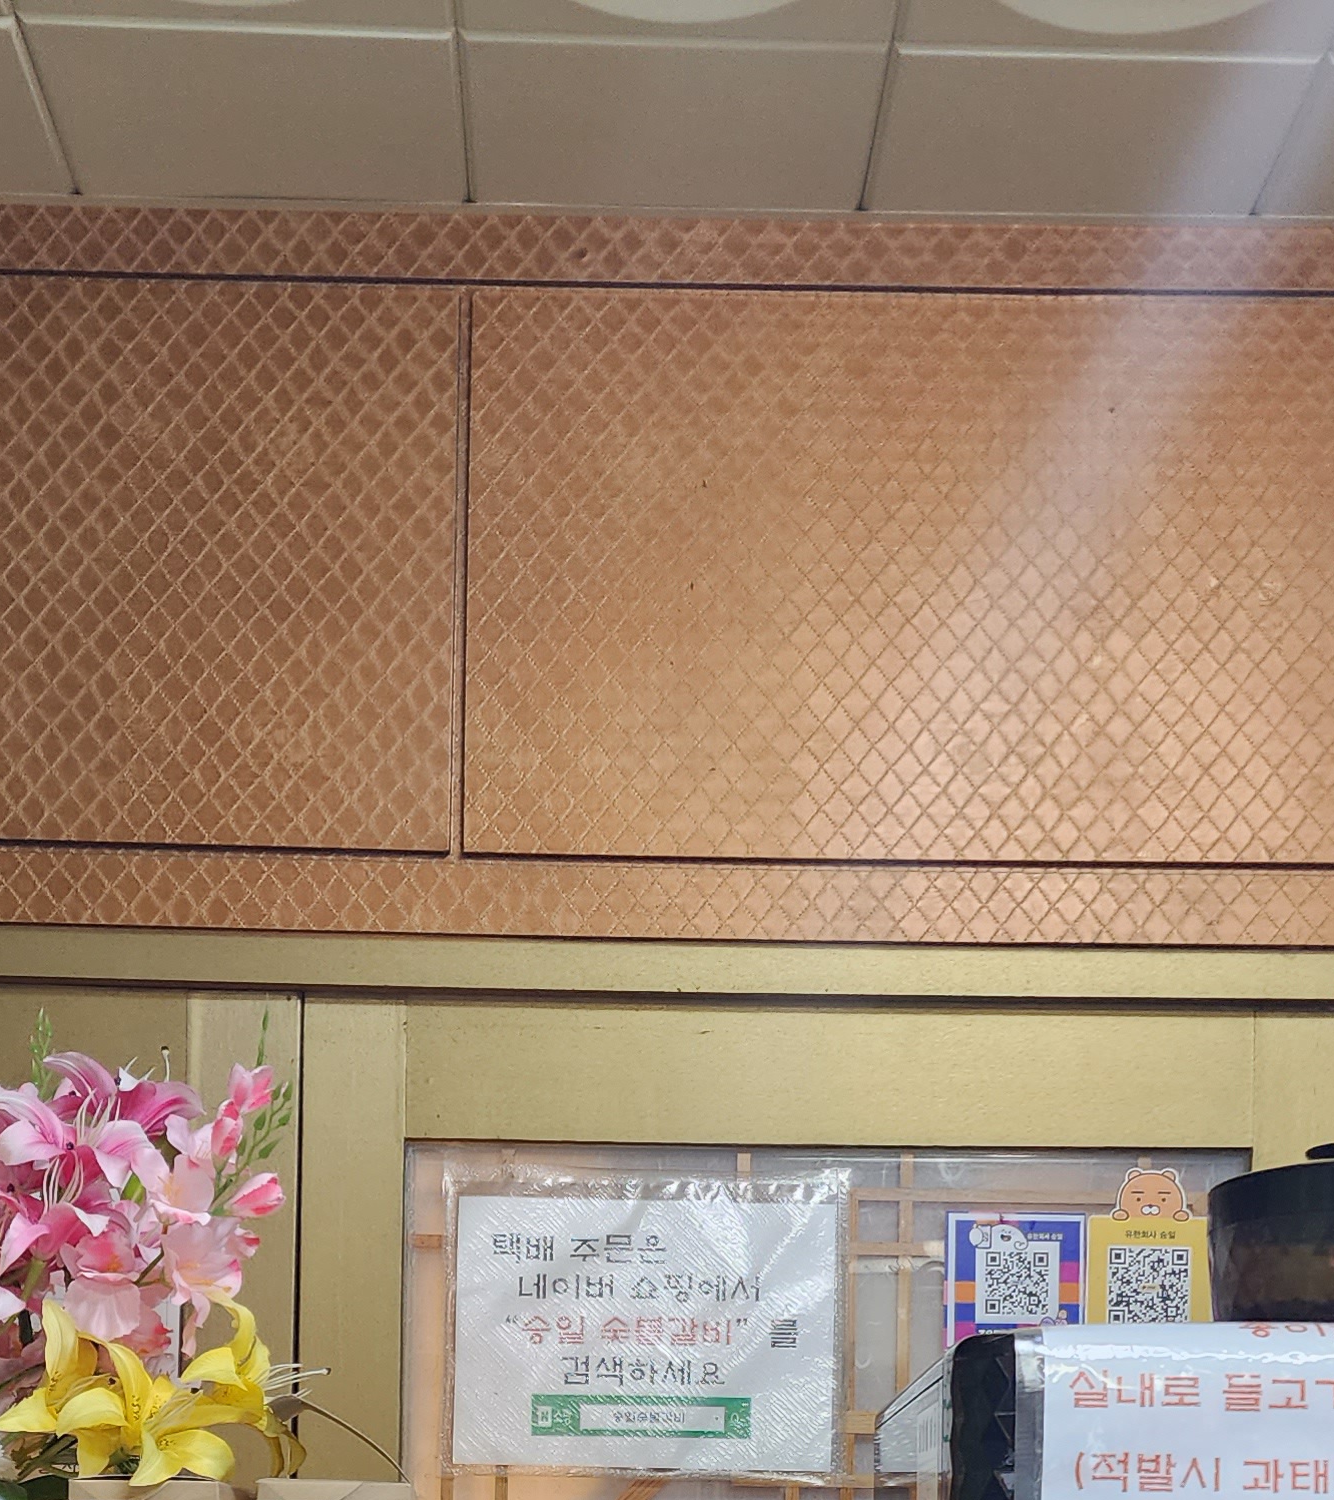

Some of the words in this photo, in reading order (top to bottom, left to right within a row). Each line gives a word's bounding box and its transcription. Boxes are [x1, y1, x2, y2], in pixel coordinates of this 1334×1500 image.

[492, 1233, 554, 1263] 택배
[570, 1234, 666, 1264] 주문은
[518, 1273, 614, 1300] 네이버
[630, 1274, 761, 1302] 쇼핑에서
[769, 1318, 798, 1349] 를
[562, 1356, 725, 1386] 검색하세요
[1070, 1372, 1201, 1411] 실내로
[1074, 1452, 1220, 1494] (적발시
